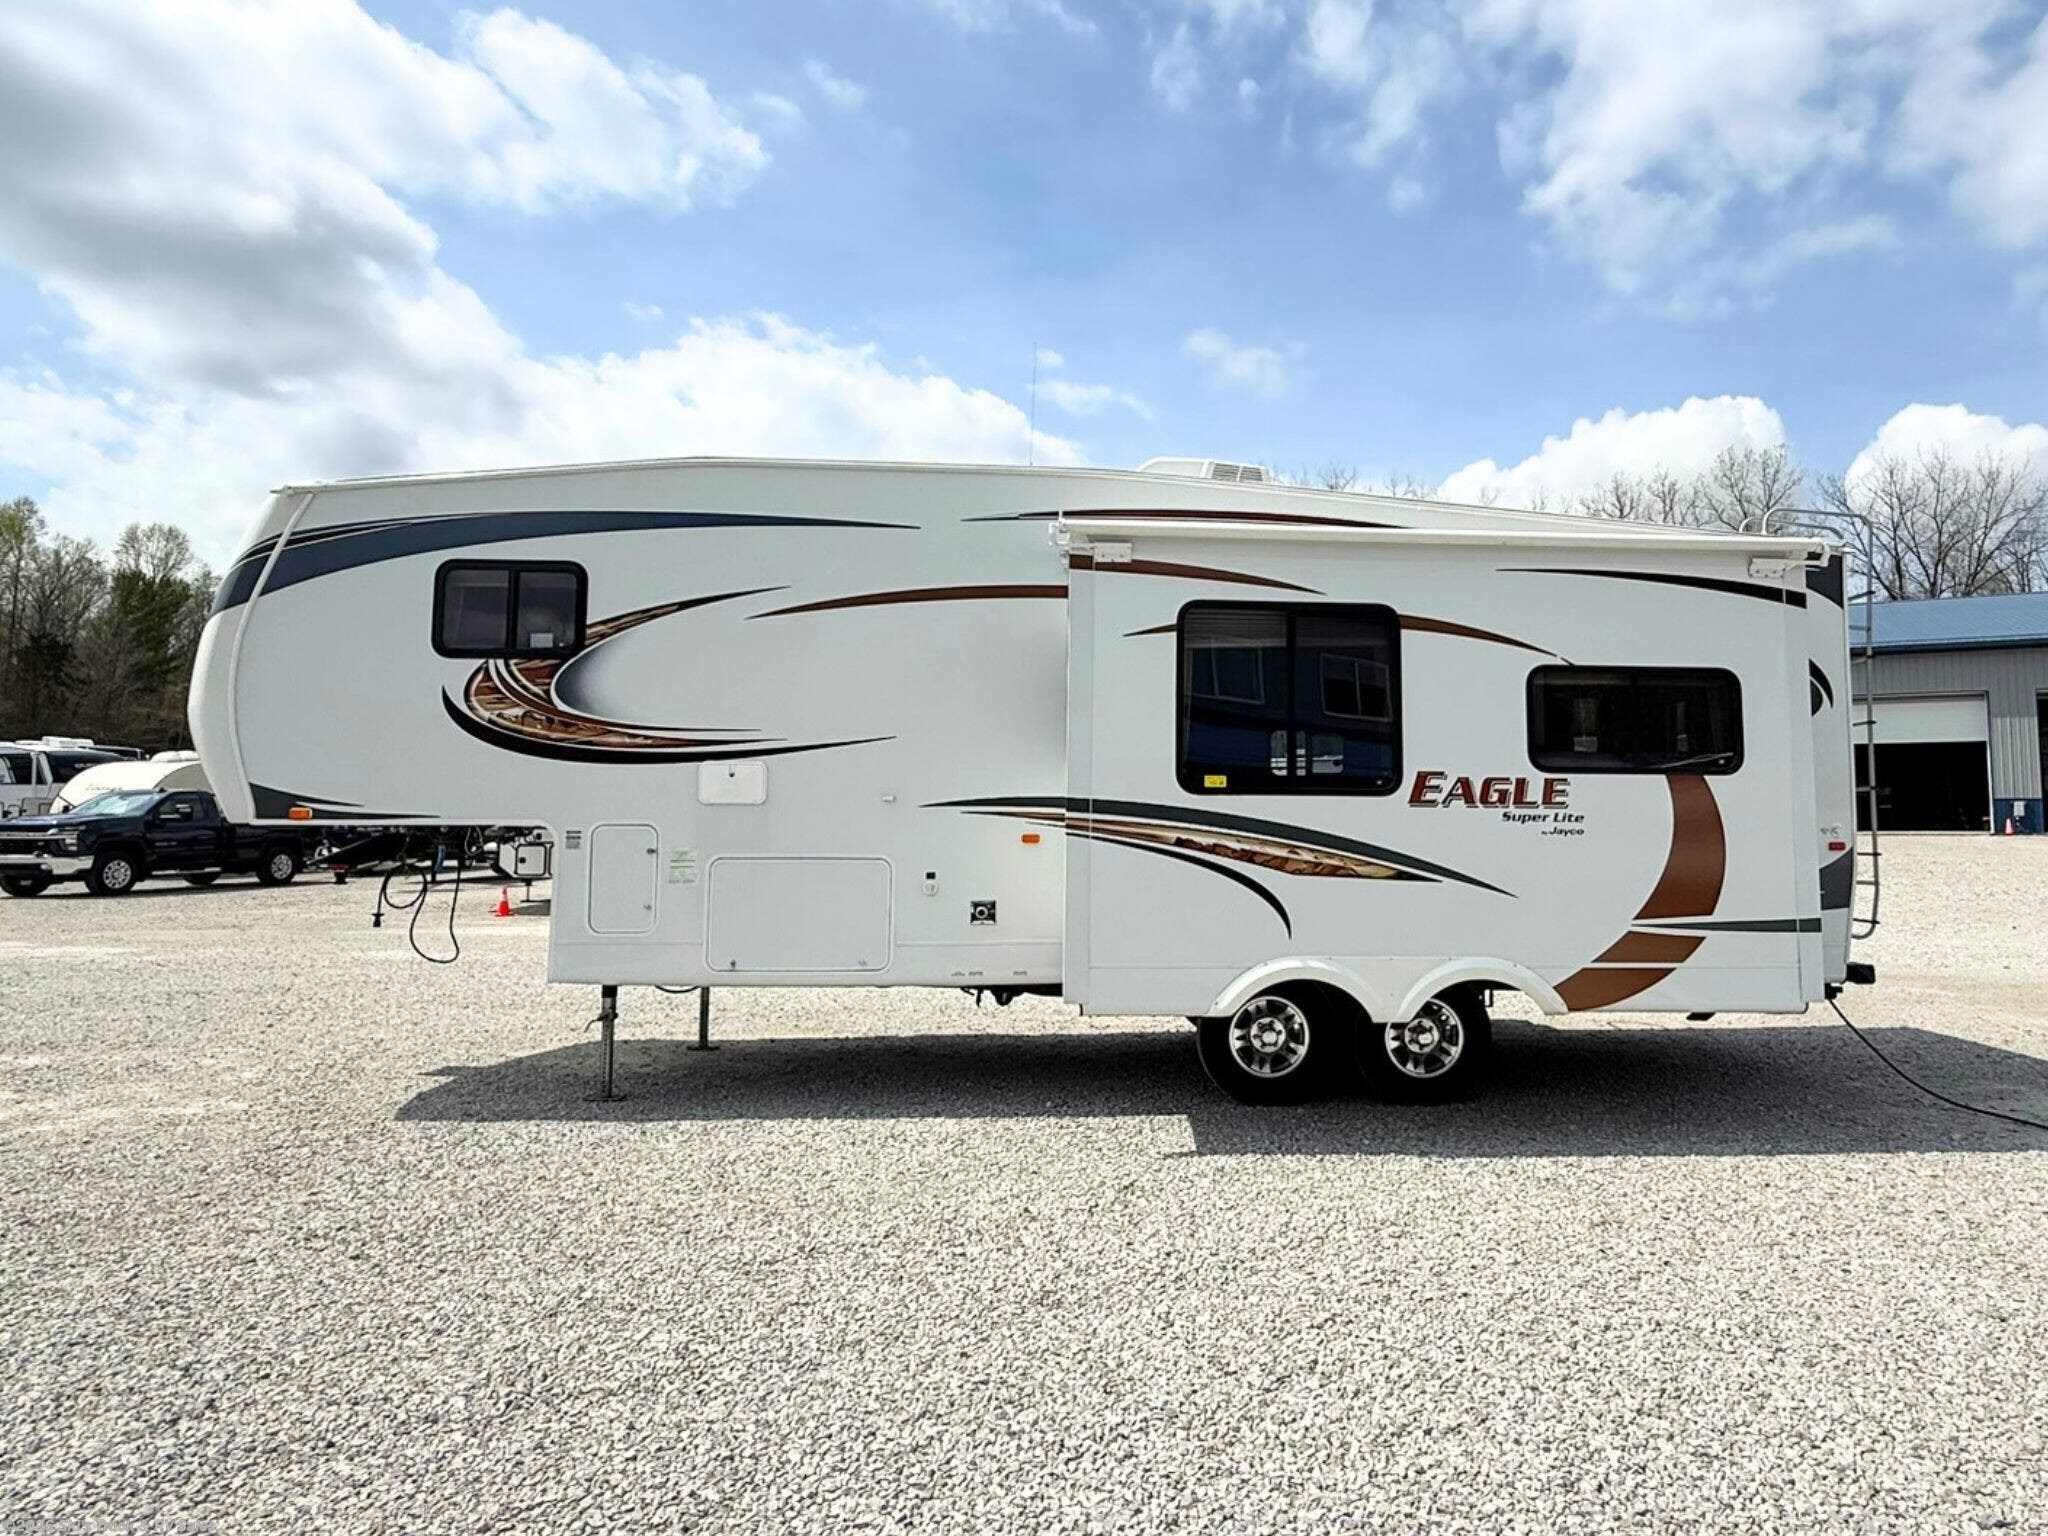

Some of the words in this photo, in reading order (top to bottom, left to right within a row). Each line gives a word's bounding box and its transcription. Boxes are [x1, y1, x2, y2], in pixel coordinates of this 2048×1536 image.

[1408, 770, 1571, 809] EAGLE
[1502, 811, 1549, 824] Super
[1552, 812, 1585, 823] Lite
[1550, 826, 1585, 837] Jayco
